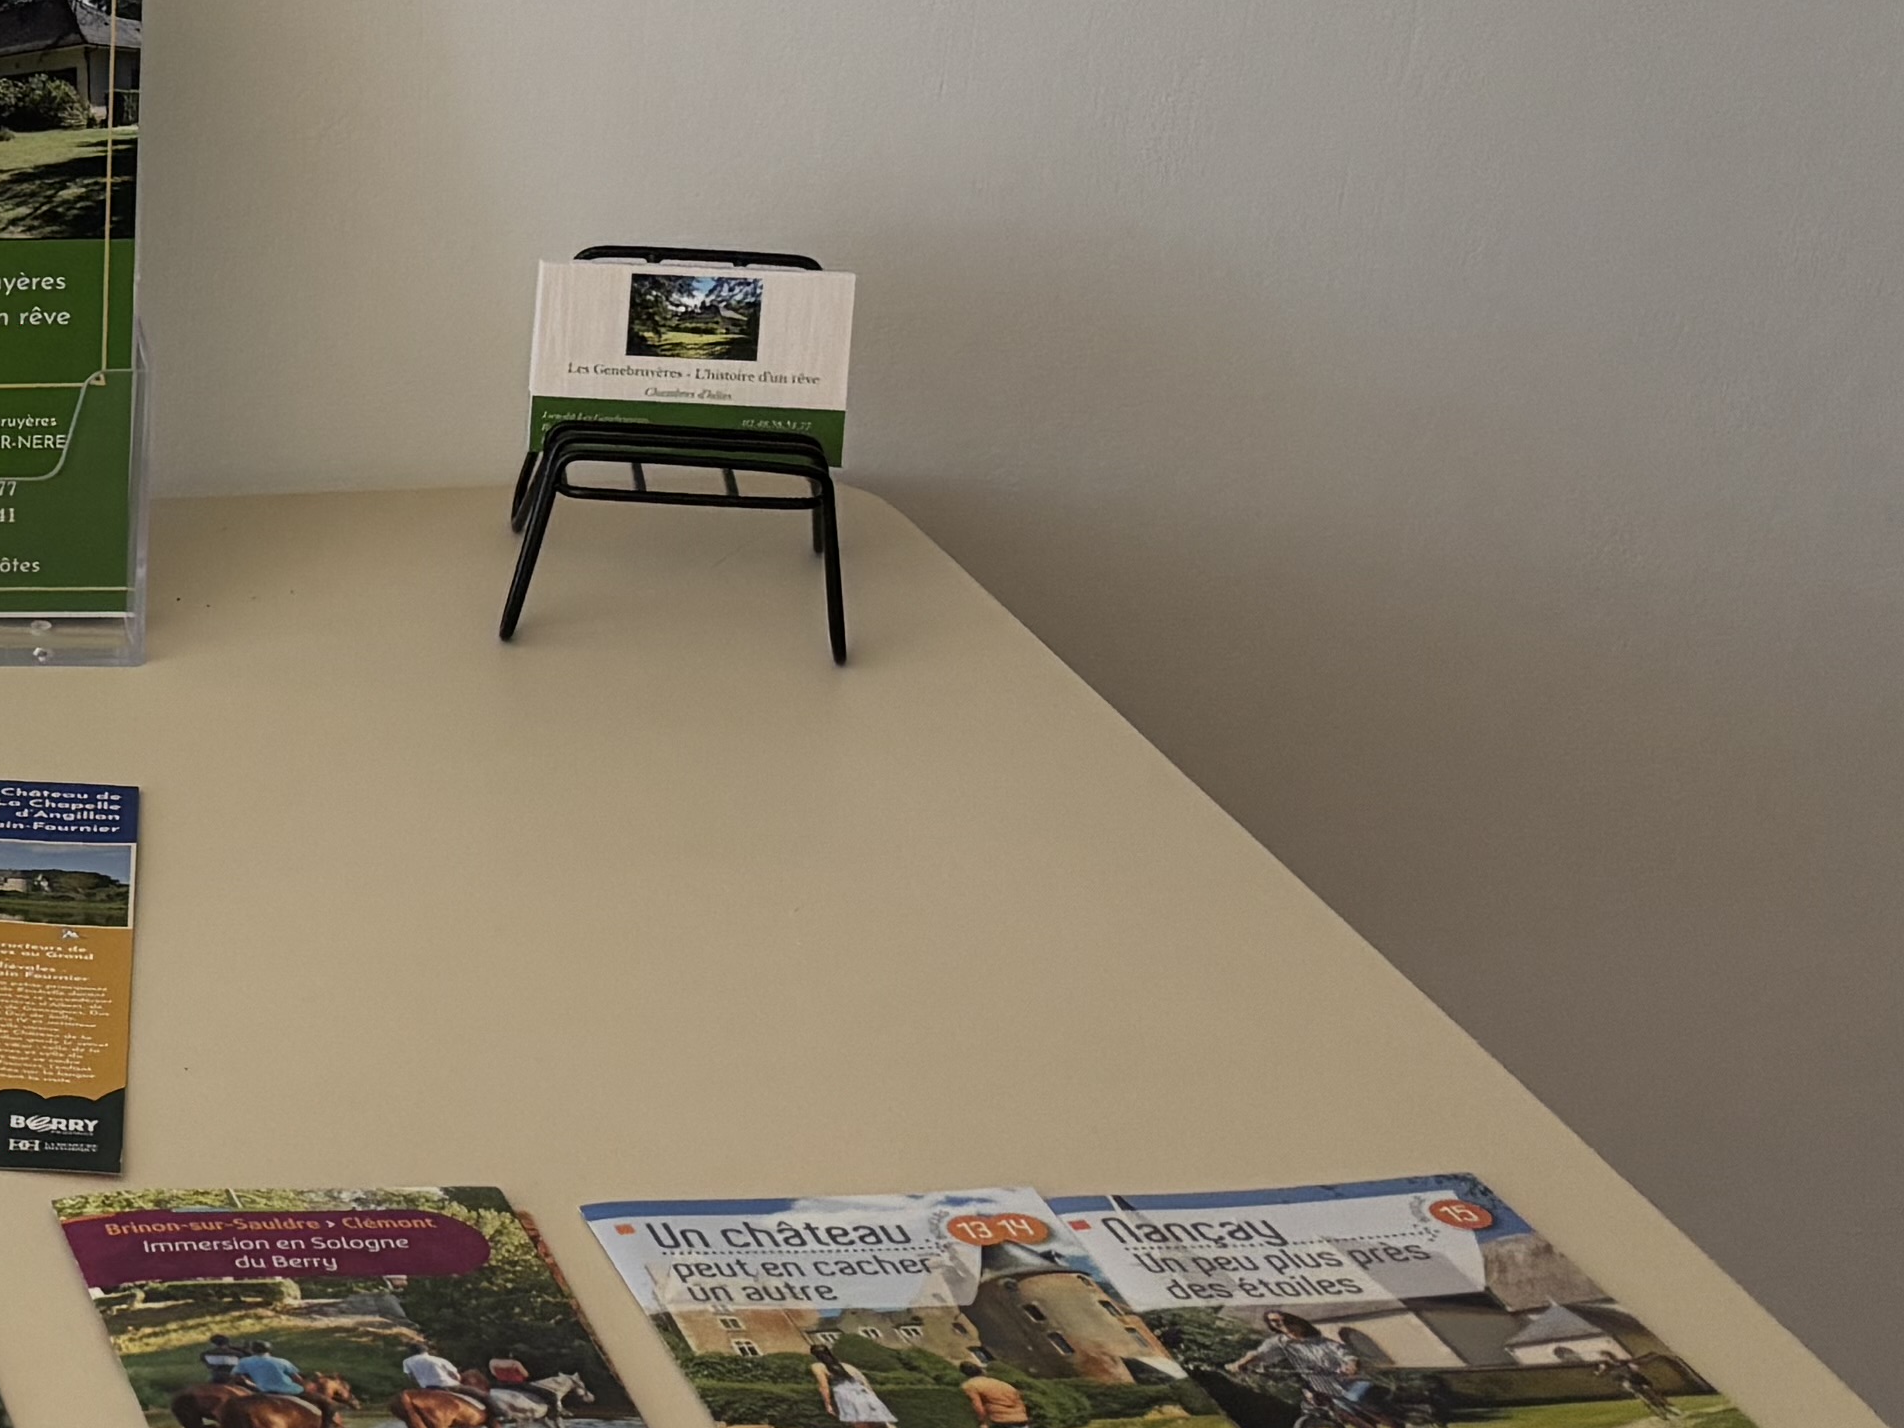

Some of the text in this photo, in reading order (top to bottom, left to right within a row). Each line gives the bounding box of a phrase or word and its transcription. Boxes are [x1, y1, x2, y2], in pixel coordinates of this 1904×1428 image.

[19, 306, 70, 324] rêve
[29, 799, 121, 811] Chapelle
[96, 791, 122, 801] de
[1441, 1204, 1479, 1222] 15
[105, 1214, 438, 1236] Brinon-sur-Sauldre Clémont
[957, 1220, 992, 1239] 13
[996, 1218, 1032, 1238] 14
[1101, 1216, 1288, 1249] Nançay
[143, 1236, 408, 1252] Immersion en Sologne
[645, 1222, 710, 1250] Un
[721, 1221, 912, 1249] château
[234, 1255, 337, 1271] du Berry
[672, 1255, 931, 1283] peut en cacher
[1132, 1241, 1431, 1277] Un peu plus près
[687, 1282, 837, 1302] un autre
[1166, 1273, 1364, 1301] des étoiles
